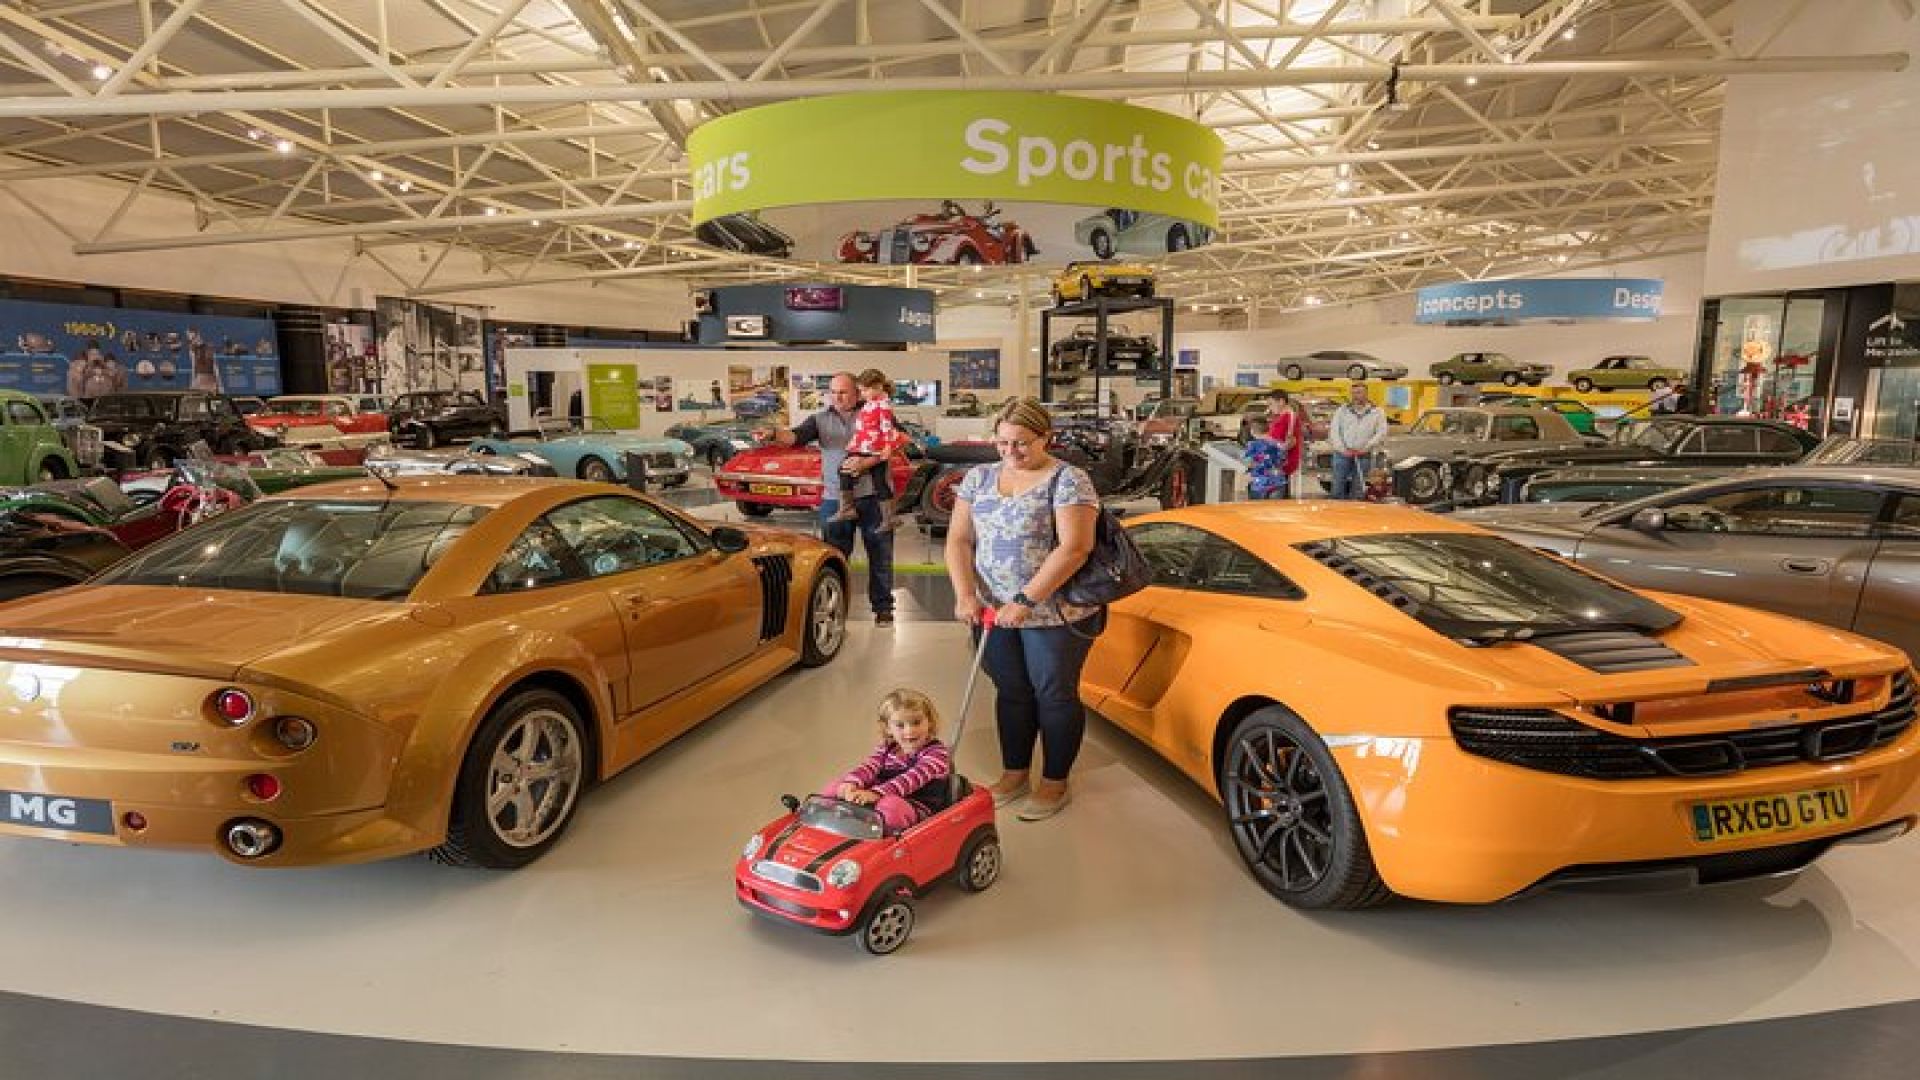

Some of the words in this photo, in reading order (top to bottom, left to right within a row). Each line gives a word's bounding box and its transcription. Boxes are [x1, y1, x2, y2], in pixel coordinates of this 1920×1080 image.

[960, 118, 1172, 191] Sports
[1423, 289, 1523, 313] concepts
[9, 793, 77, 825] MG
[1712, 798, 1791, 836] RX60
[1797, 787, 1848, 823] GTU
